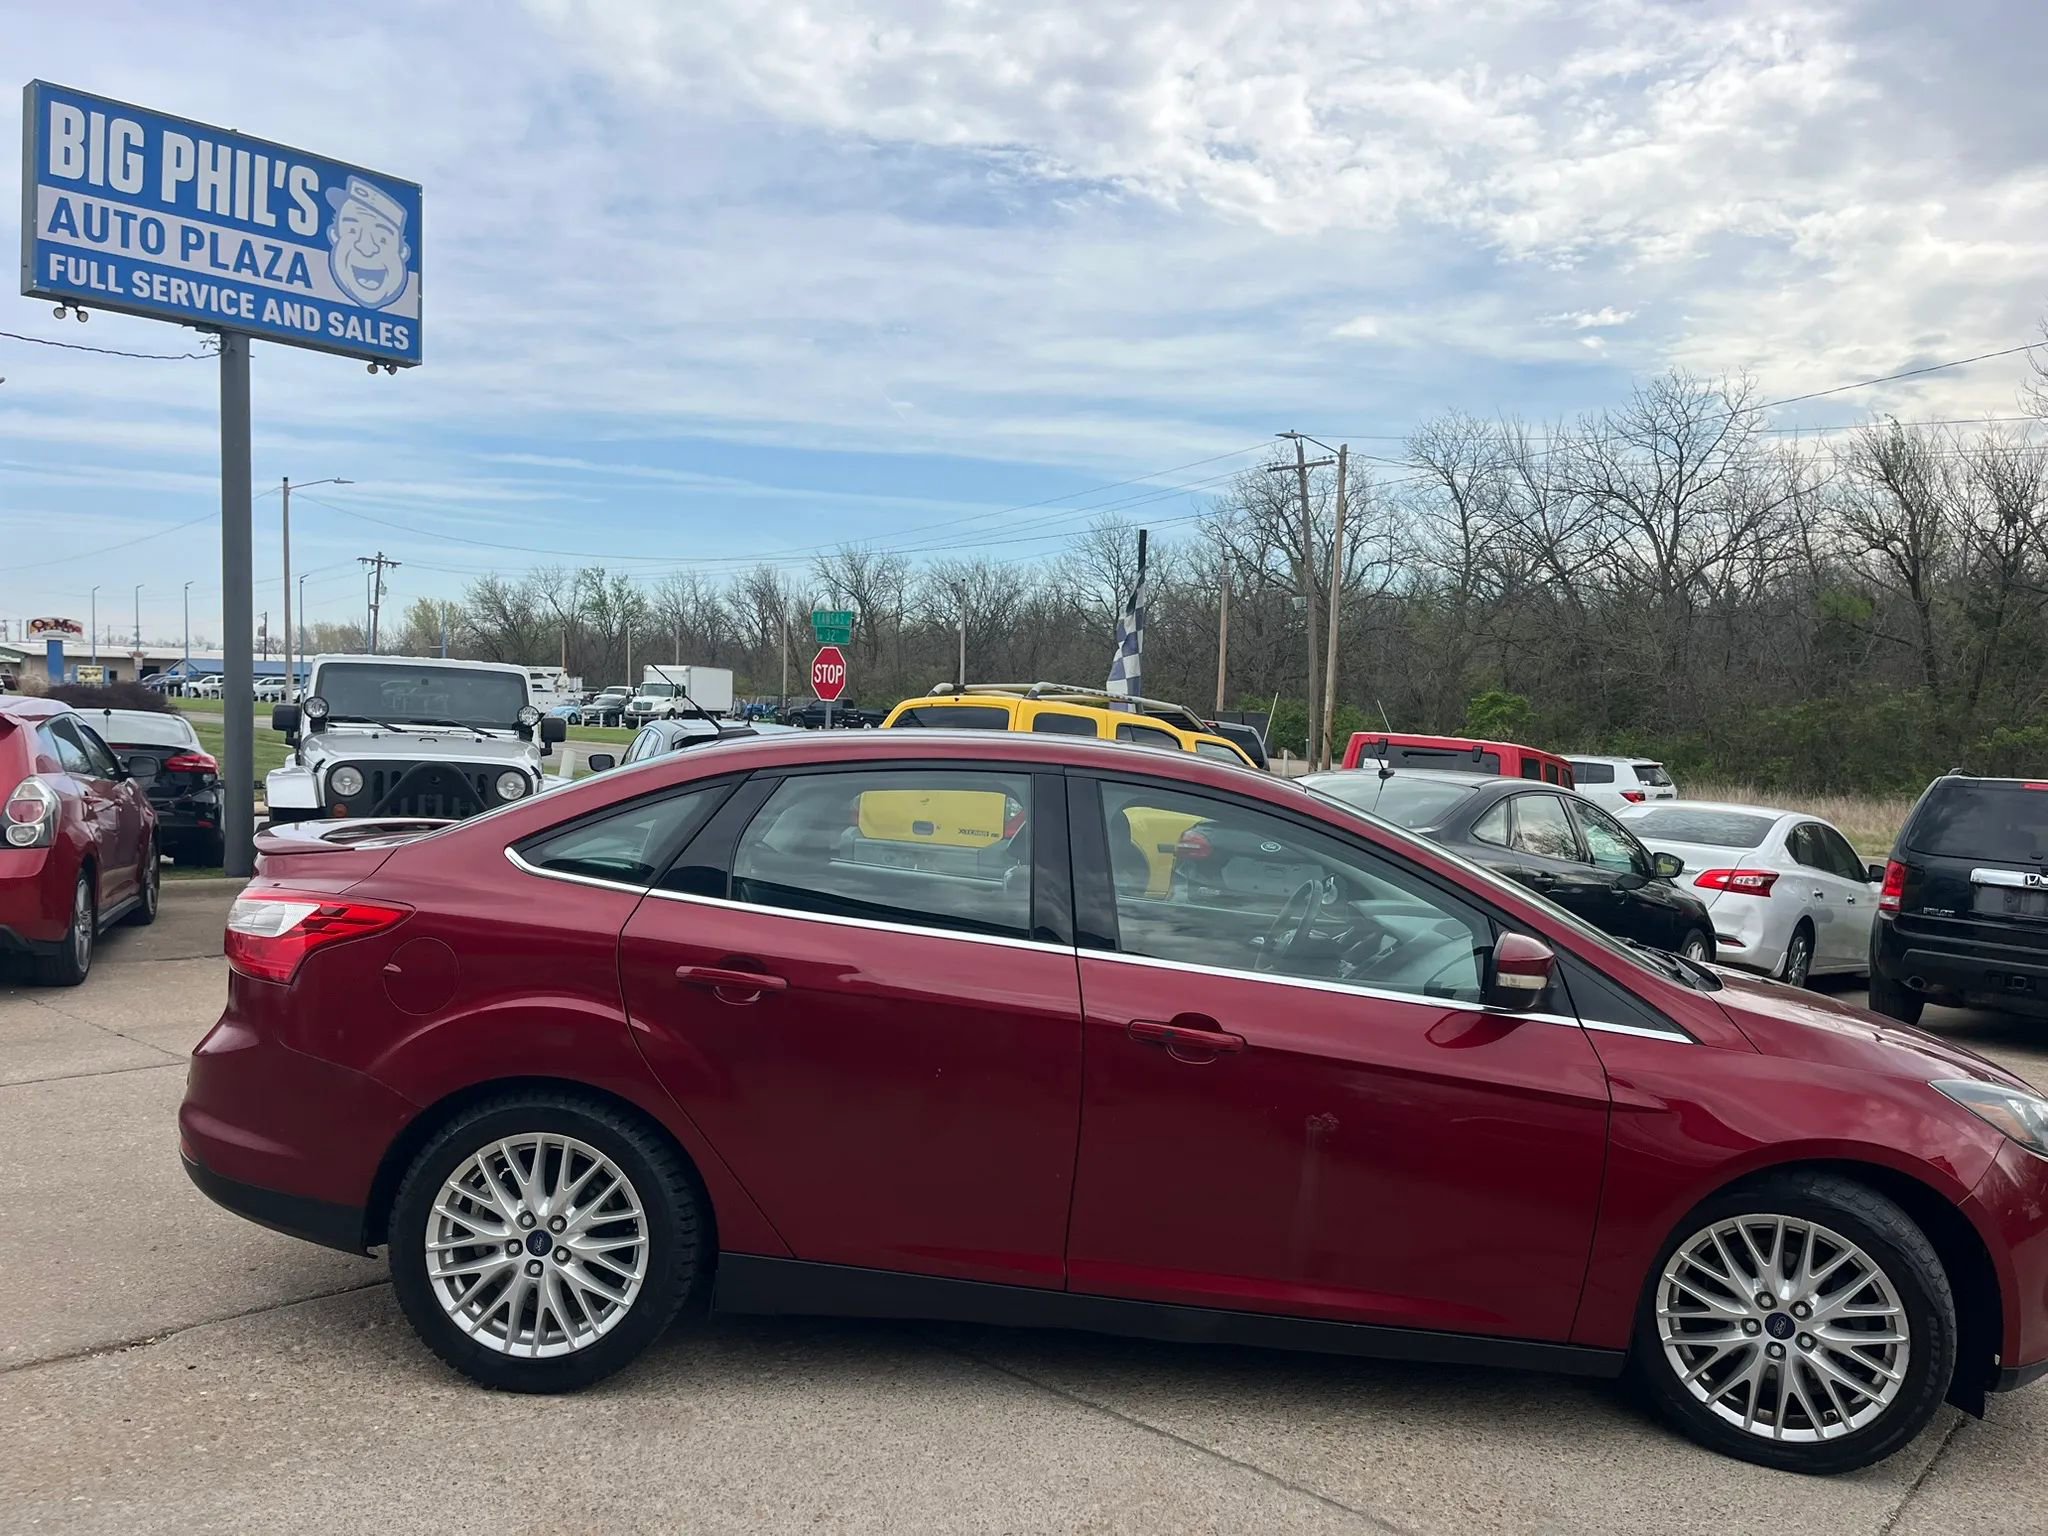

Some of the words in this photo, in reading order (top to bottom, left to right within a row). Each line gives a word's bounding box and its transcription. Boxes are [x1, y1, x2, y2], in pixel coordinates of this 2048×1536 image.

[49, 100, 145, 195] BIG
[161, 130, 320, 236] PHIL'S
[47, 197, 166, 255] AUTO
[180, 226, 313, 290] PLAZA
[49, 252, 124, 294] FULL
[132, 270, 255, 320] SERVICE
[262, 298, 321, 332] AND
[328, 315, 409, 350] SALES
[814, 663, 843, 684] STOP
